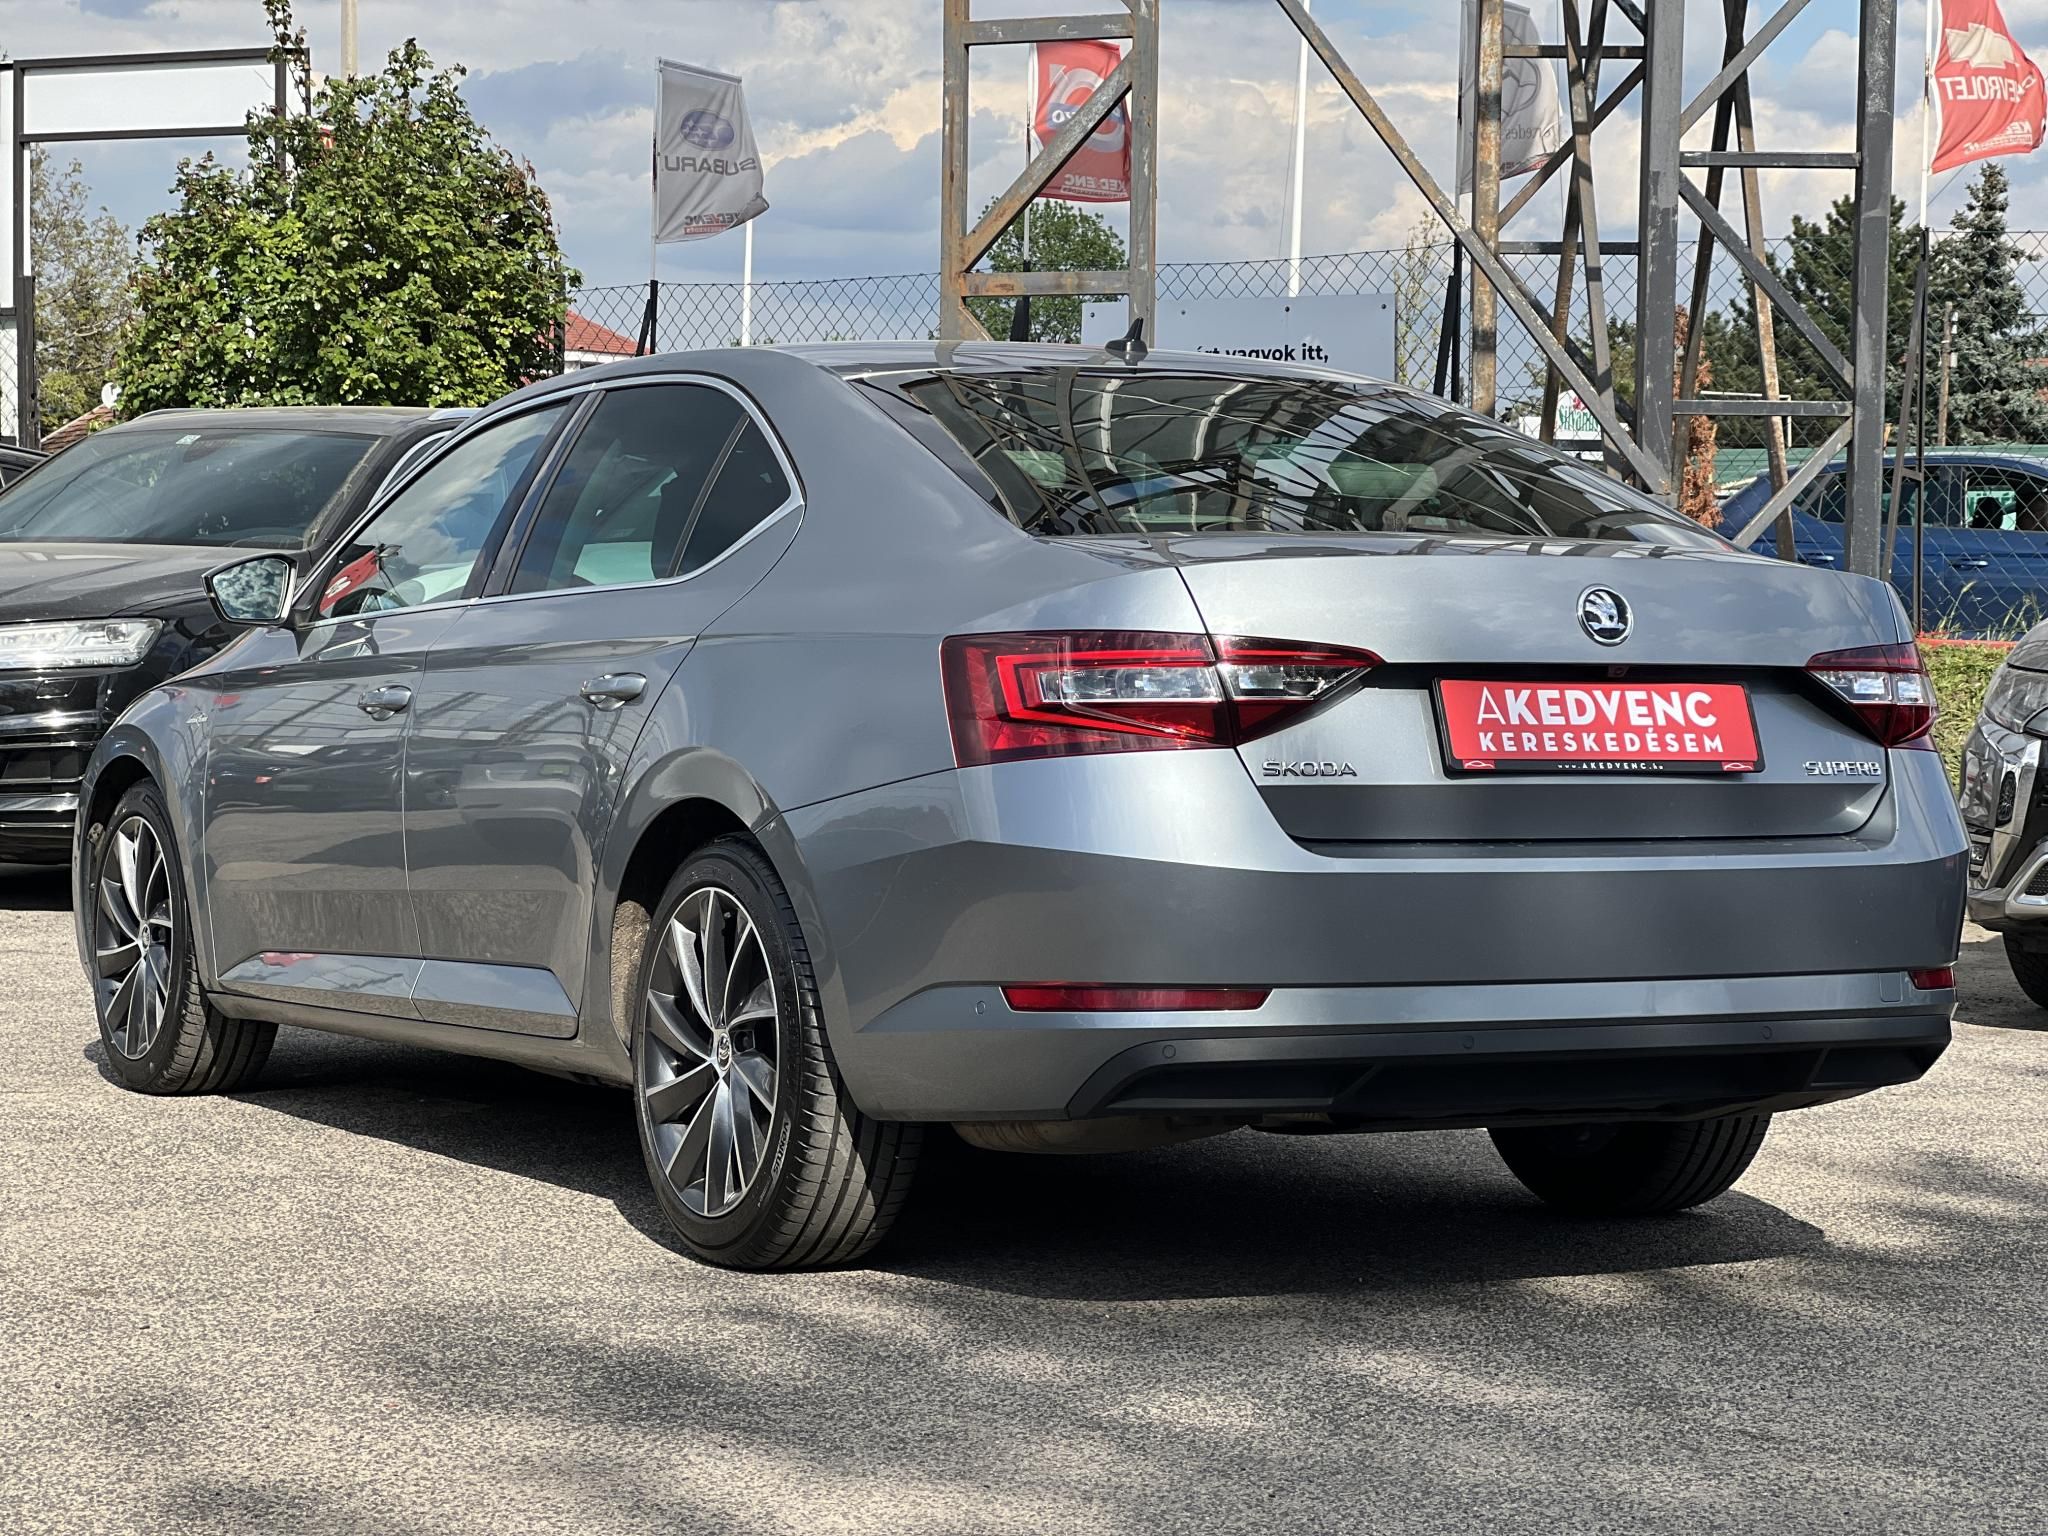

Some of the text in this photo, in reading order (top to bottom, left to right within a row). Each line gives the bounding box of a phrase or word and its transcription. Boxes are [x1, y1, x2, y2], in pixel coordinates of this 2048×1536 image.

[1302, 343, 1329, 363] itt,
[1478, 727, 1724, 753] KERESKEDÉSEM
[1262, 758, 1358, 777] ŠKODA
[1804, 761, 1881, 776] SUPERB
